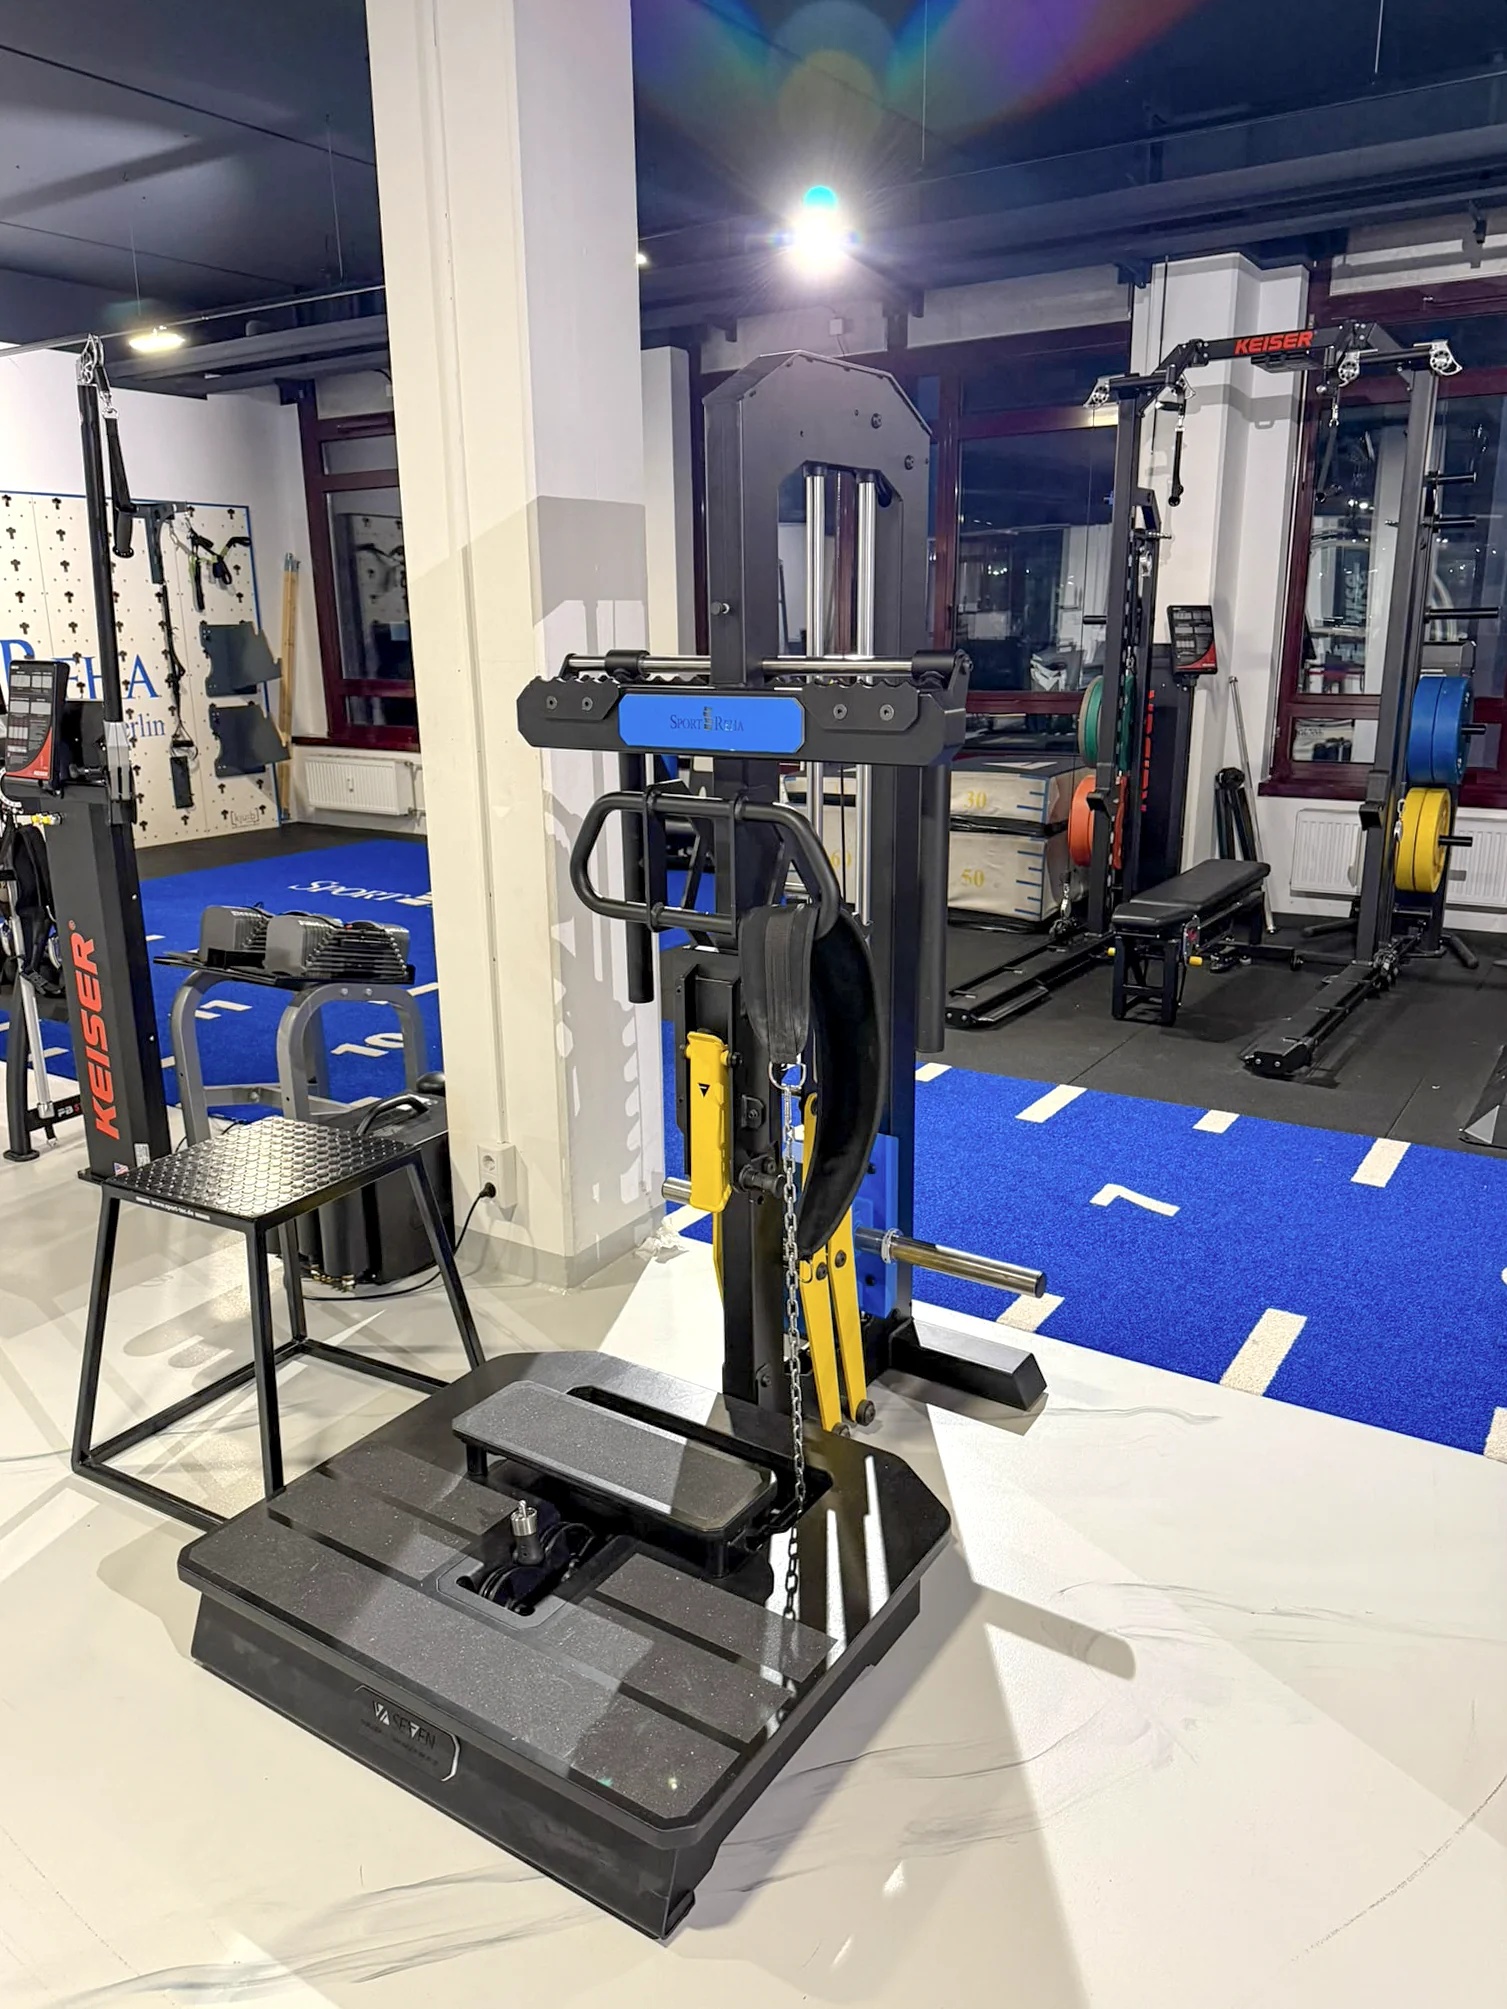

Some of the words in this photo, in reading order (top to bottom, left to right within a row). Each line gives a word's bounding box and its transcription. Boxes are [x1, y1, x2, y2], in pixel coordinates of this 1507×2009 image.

[1233, 330, 1314, 355] KEISER
[125, 712, 166, 738] erlin
[964, 791, 987, 808] 30
[961, 868, 985, 887] 50
